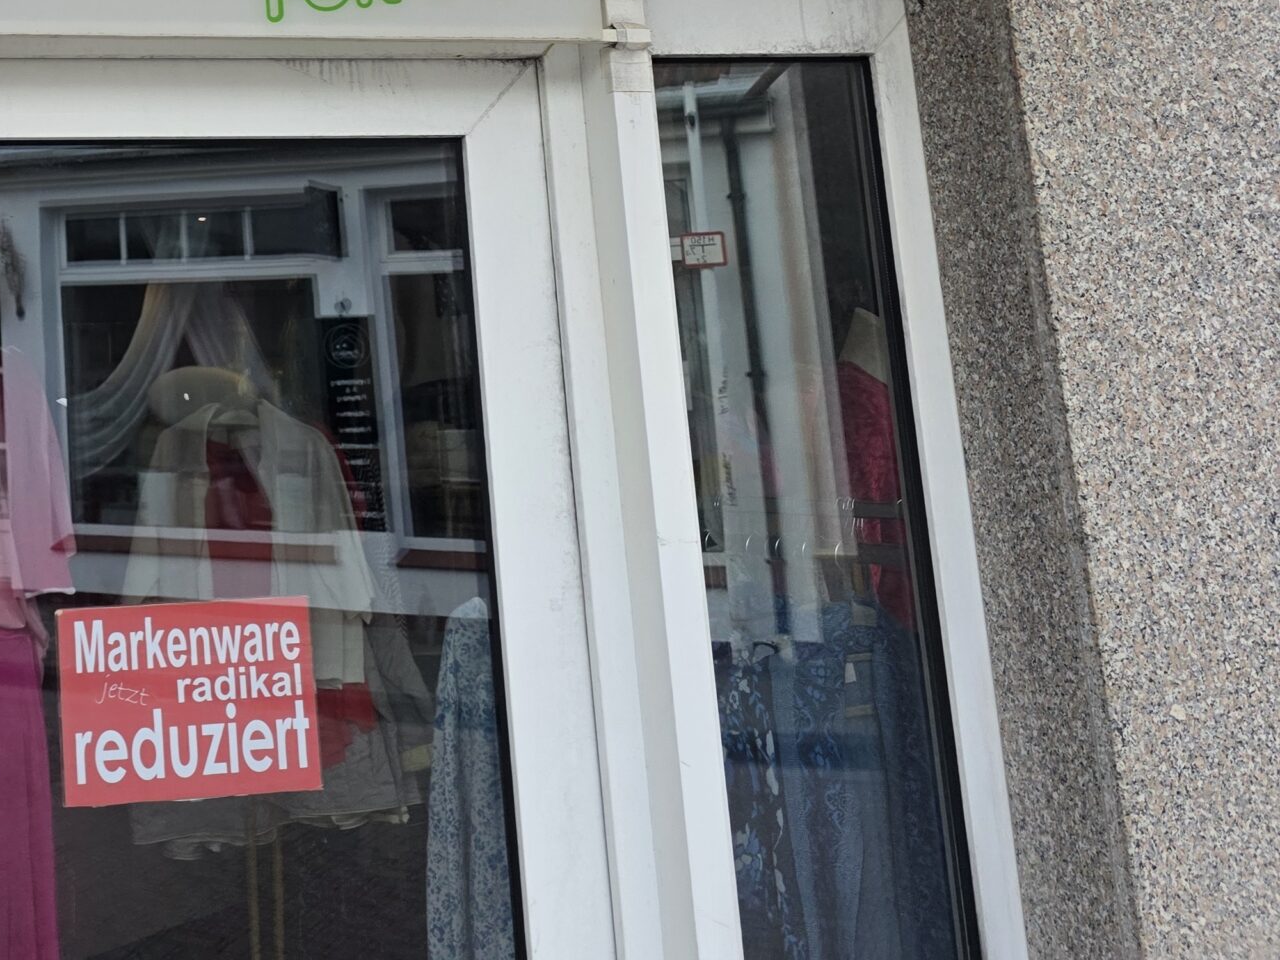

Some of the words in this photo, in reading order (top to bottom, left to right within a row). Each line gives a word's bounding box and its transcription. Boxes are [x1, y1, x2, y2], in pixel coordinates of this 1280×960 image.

[73, 616, 301, 674] Markenware
[95, 671, 151, 706] jetzt
[176, 663, 302, 704] radikal
[74, 700, 310, 785] reduziert
